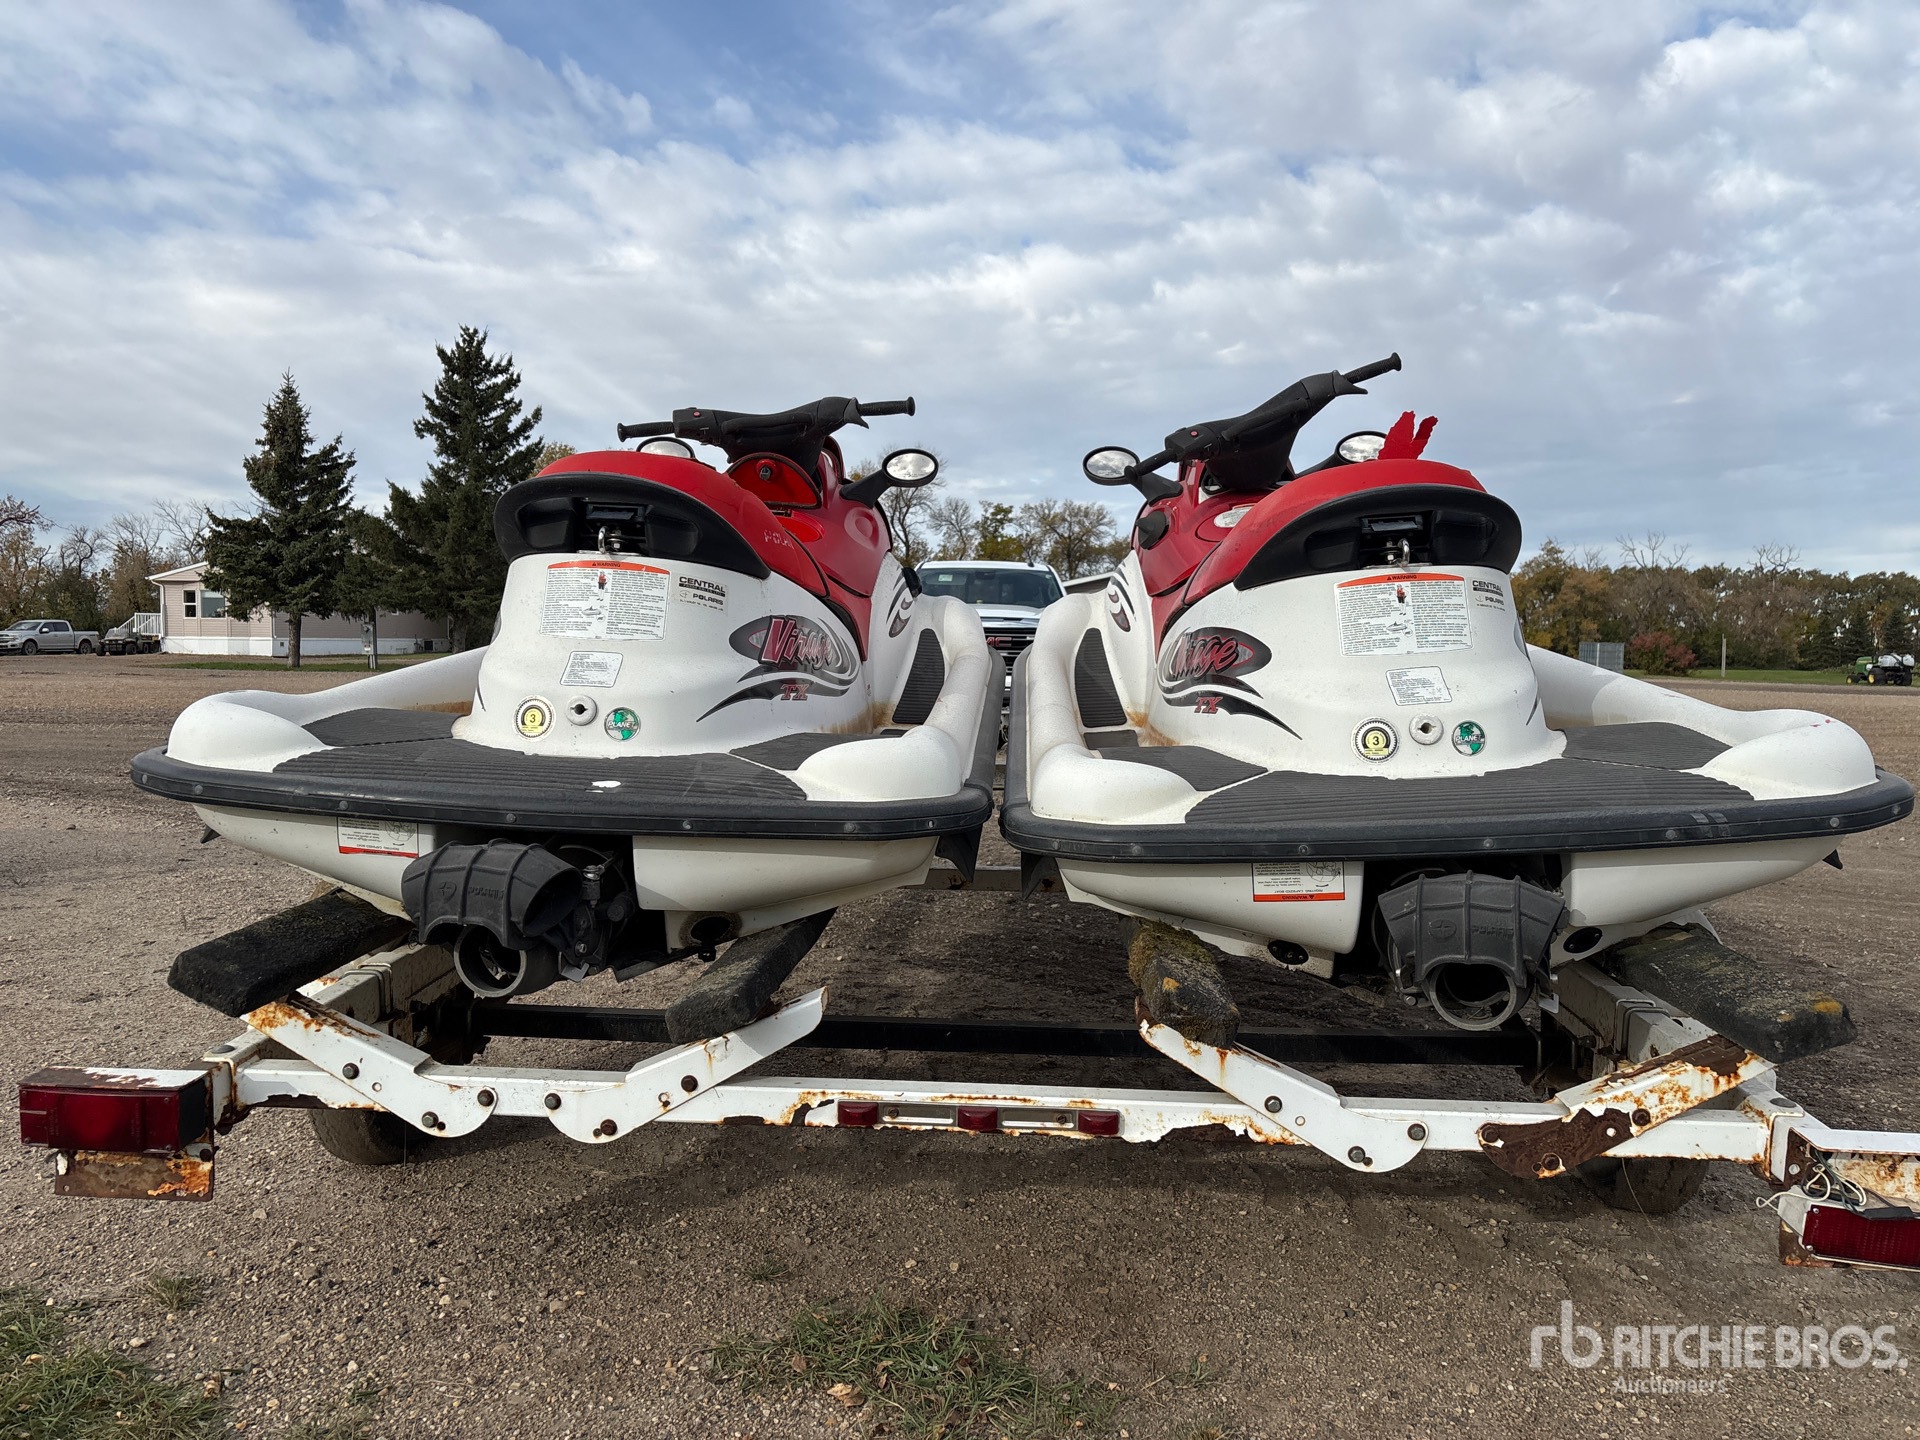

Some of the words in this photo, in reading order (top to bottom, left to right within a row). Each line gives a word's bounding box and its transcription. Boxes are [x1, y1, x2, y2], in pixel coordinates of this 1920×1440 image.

[679, 576, 726, 593] CENTRAL
[1472, 580, 1503, 593] CENTRAL
[693, 593, 724, 605] POLARIS
[986, 637, 1012, 647] MC
[780, 684, 810, 701] TX
[1194, 697, 1223, 714] TX
[529, 713, 536, 724] 3
[1372, 735, 1380, 746] 3
[1455, 734, 1481, 743] PLANET
